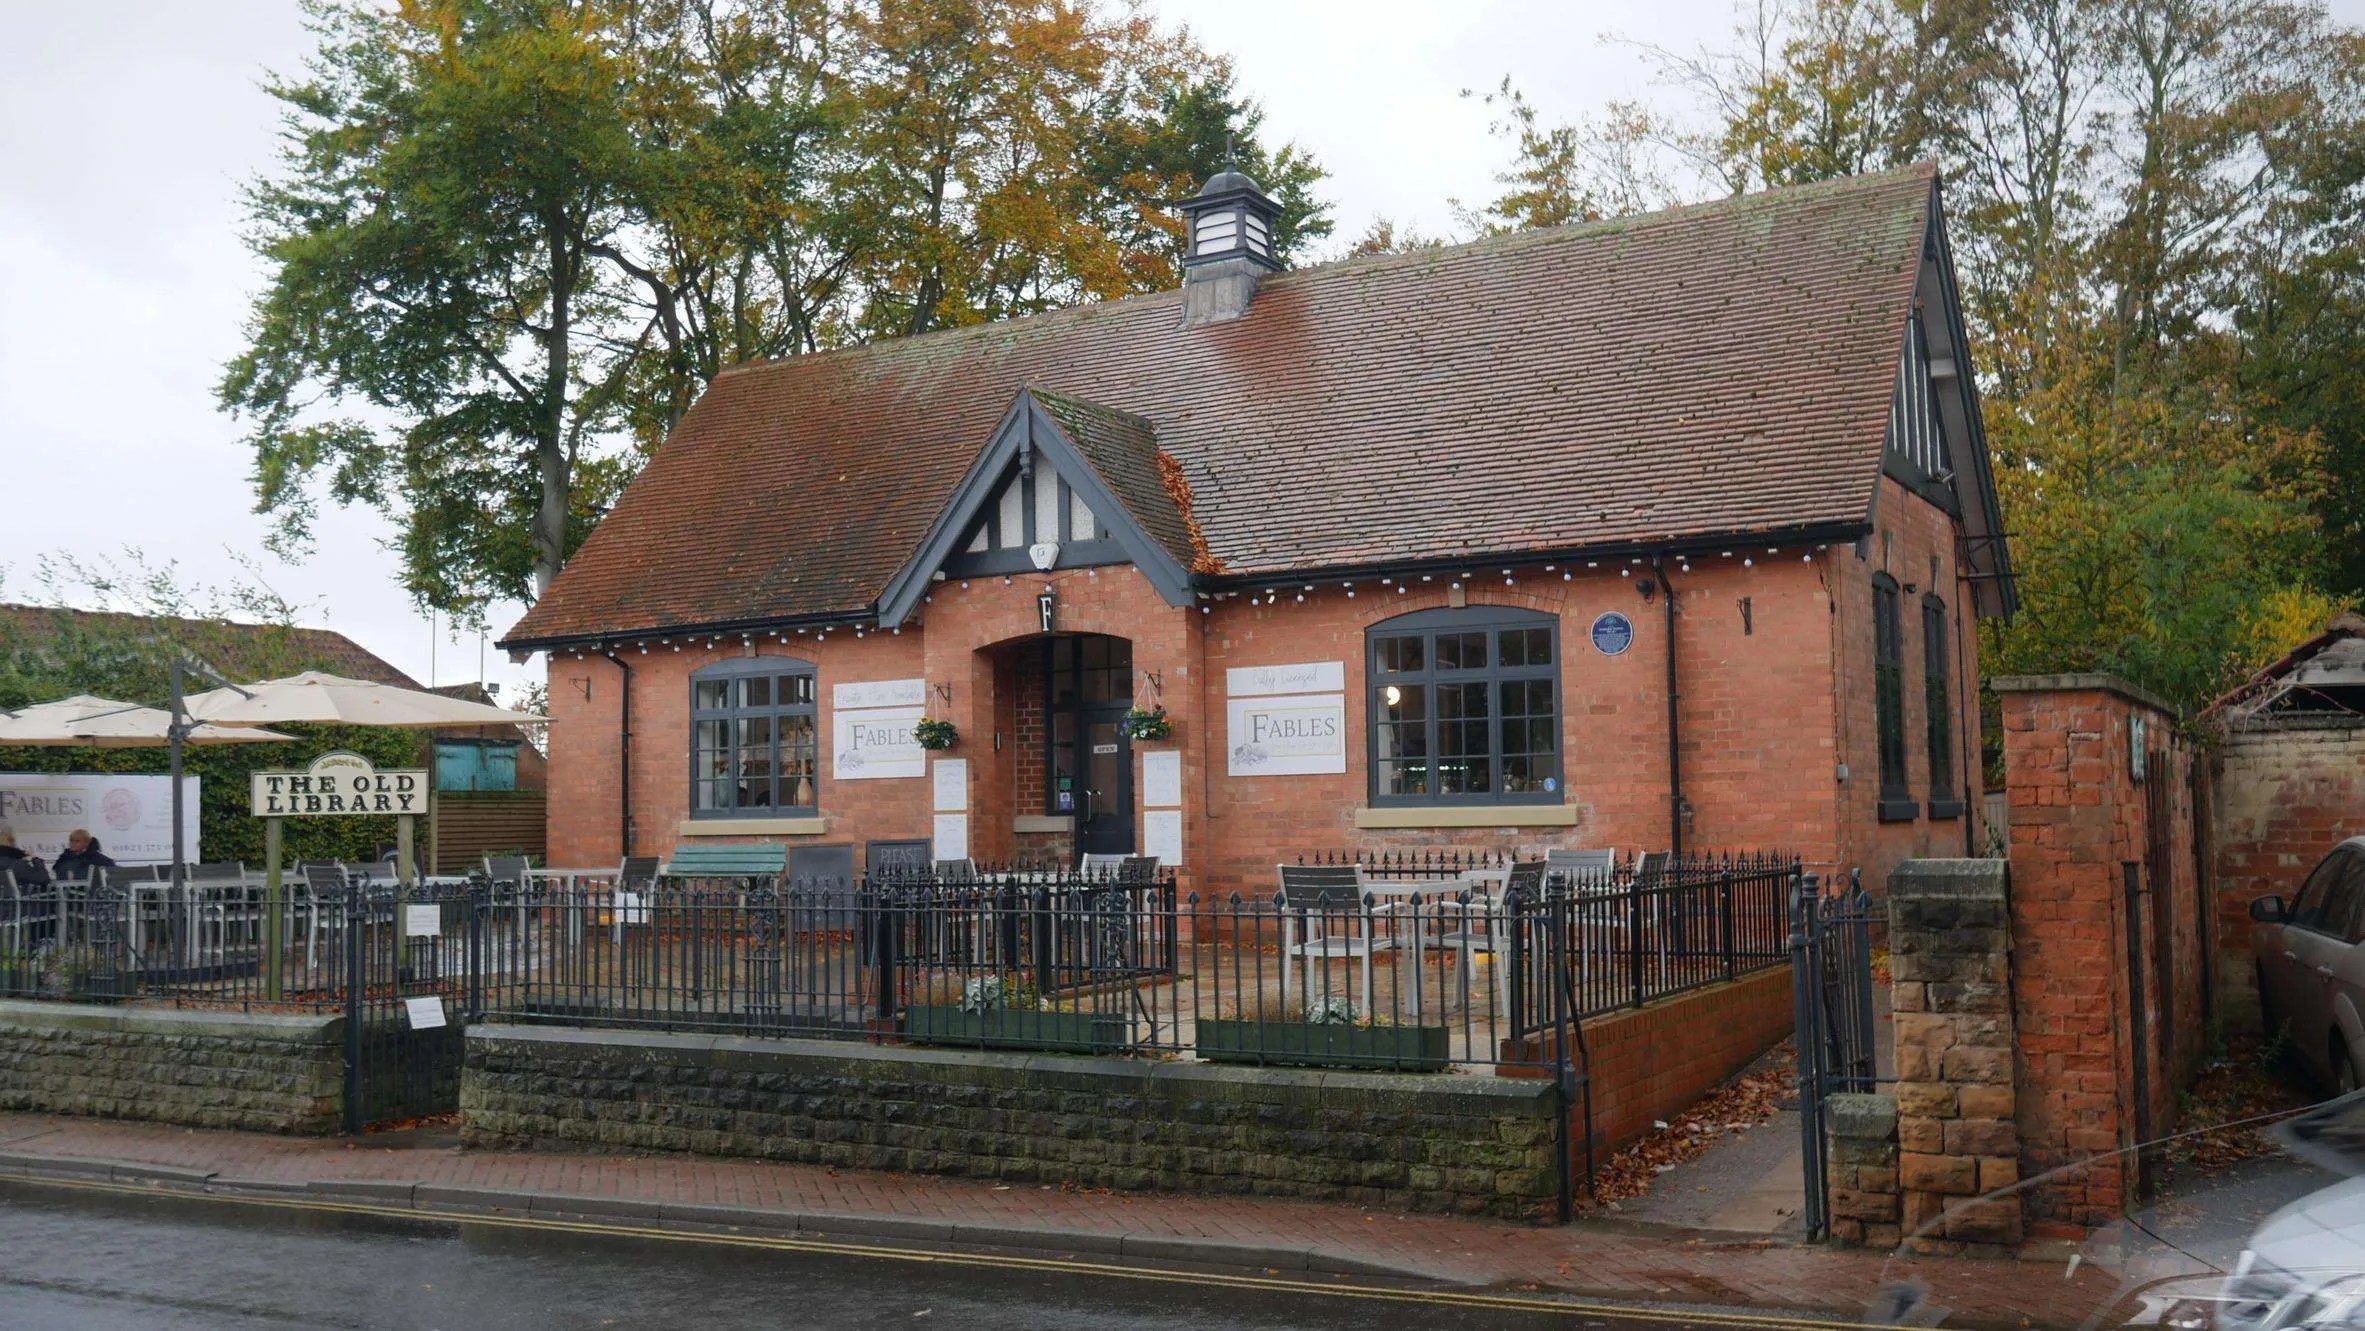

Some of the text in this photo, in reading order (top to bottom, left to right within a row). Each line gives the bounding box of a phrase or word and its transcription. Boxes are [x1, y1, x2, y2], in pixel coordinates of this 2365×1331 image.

[1040, 596, 1052, 632] F
[266, 775, 415, 794] THE OLD
[266, 793, 415, 813] LIBRARY
